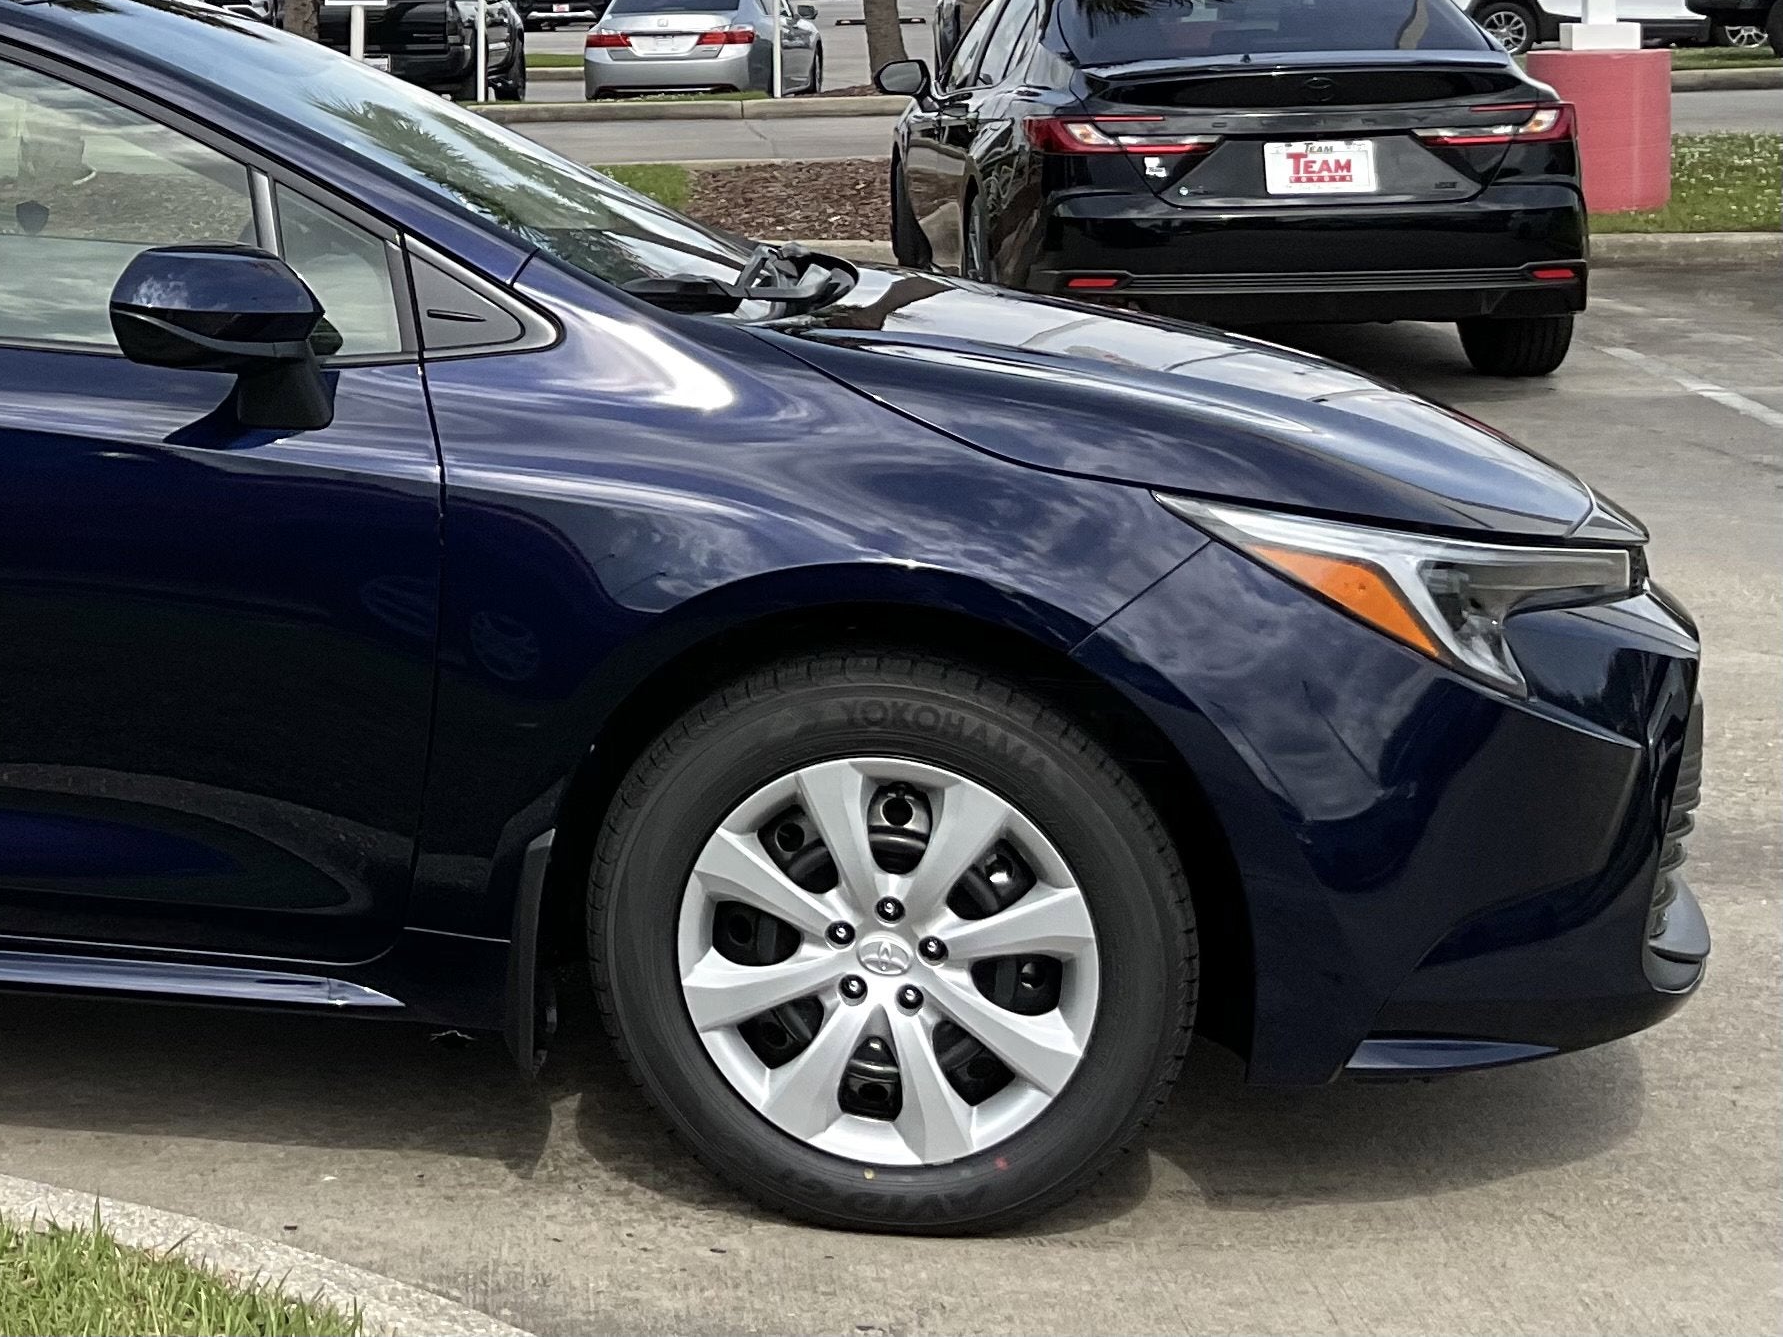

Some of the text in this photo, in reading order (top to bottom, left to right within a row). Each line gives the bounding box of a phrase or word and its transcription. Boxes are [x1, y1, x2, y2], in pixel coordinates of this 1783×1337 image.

[1303, 142, 1334, 154] TEAM
[1286, 152, 1352, 175] TEAM
[1290, 175, 1353, 183] TOYOTA
[838, 697, 1051, 778] YOKOHAMA
